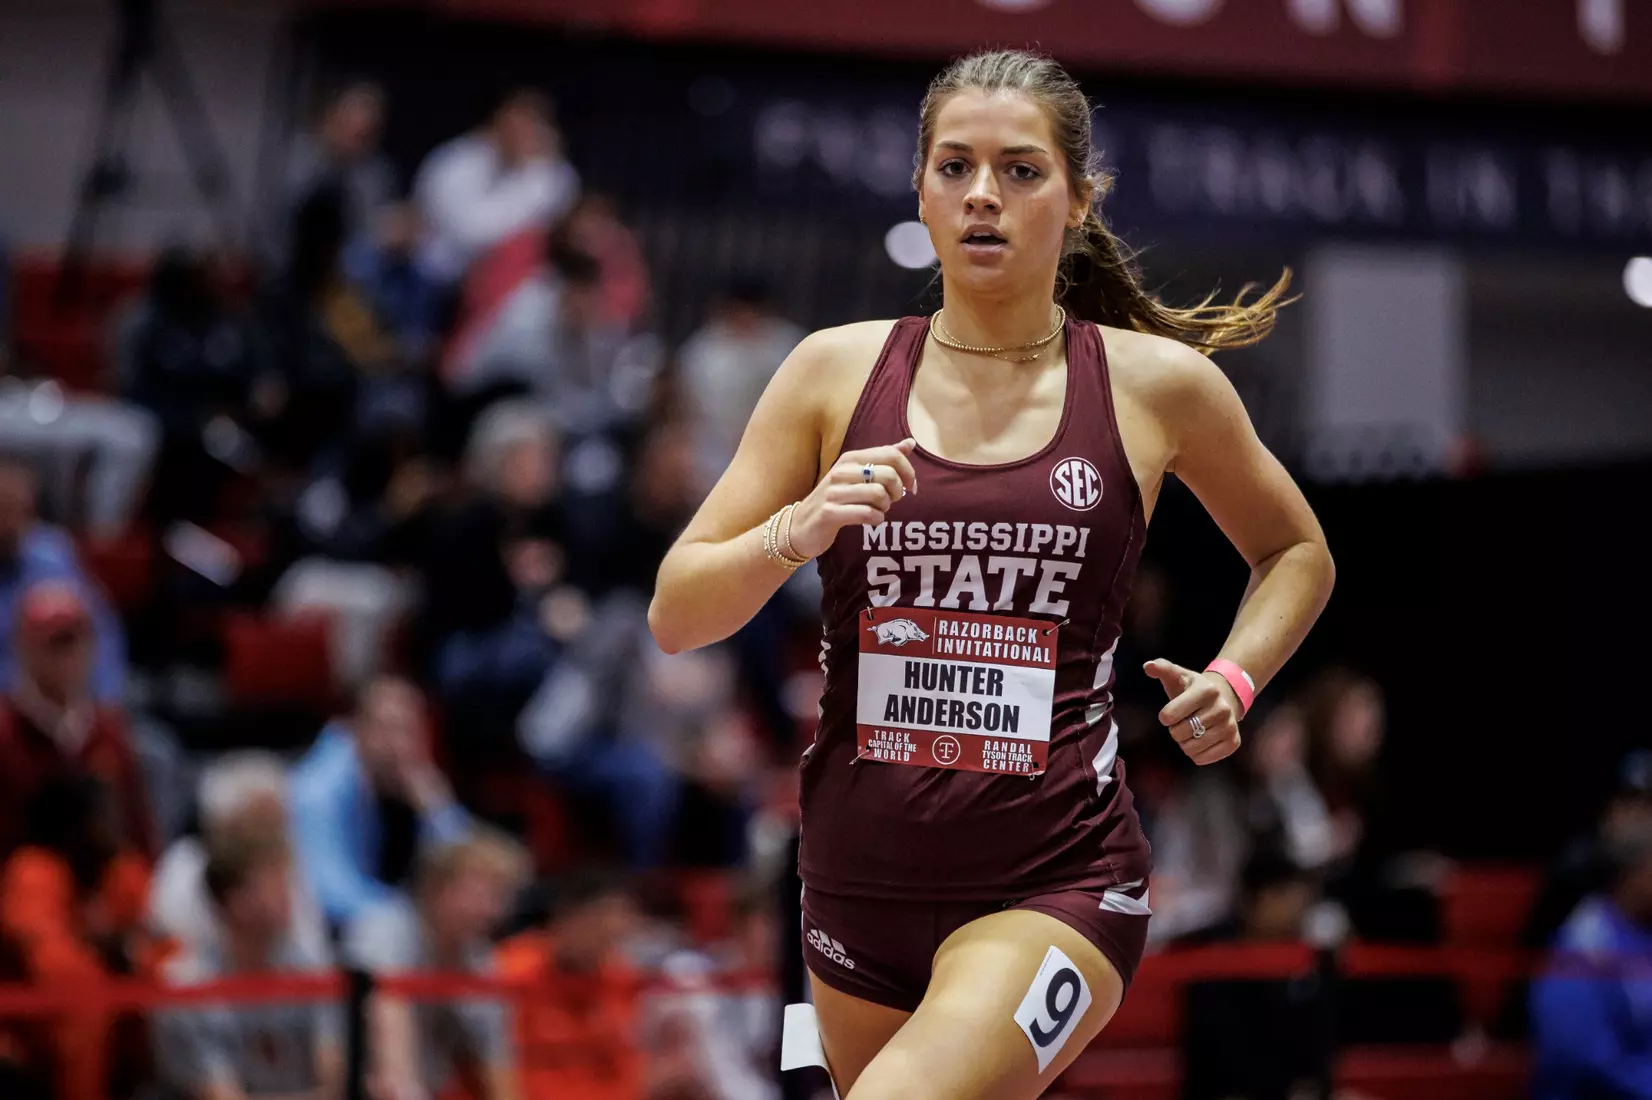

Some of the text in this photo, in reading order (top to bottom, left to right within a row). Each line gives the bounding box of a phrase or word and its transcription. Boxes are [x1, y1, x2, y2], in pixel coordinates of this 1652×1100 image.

[1054, 461, 1099, 507] SEC
[862, 520, 1091, 559] MISSISSIPPI
[866, 554, 1083, 618] STATE
[938, 619, 1038, 644] RAZORBACK
[937, 637, 1051, 664] INVITATIONAL
[904, 660, 1005, 697] HUNTER
[883, 694, 1021, 734] ANDERSON
[868, 739, 917, 753] CAPITAL OF THE
[874, 729, 911, 744] TRACK
[984, 740, 1032, 755] RANDAL
[873, 747, 910, 763] WORLD
[982, 750, 1033, 763] TYSON TRACK
[983, 758, 1030, 773] CENTER
[806, 932, 856, 970] adidas
[1028, 967, 1082, 1049] 9
